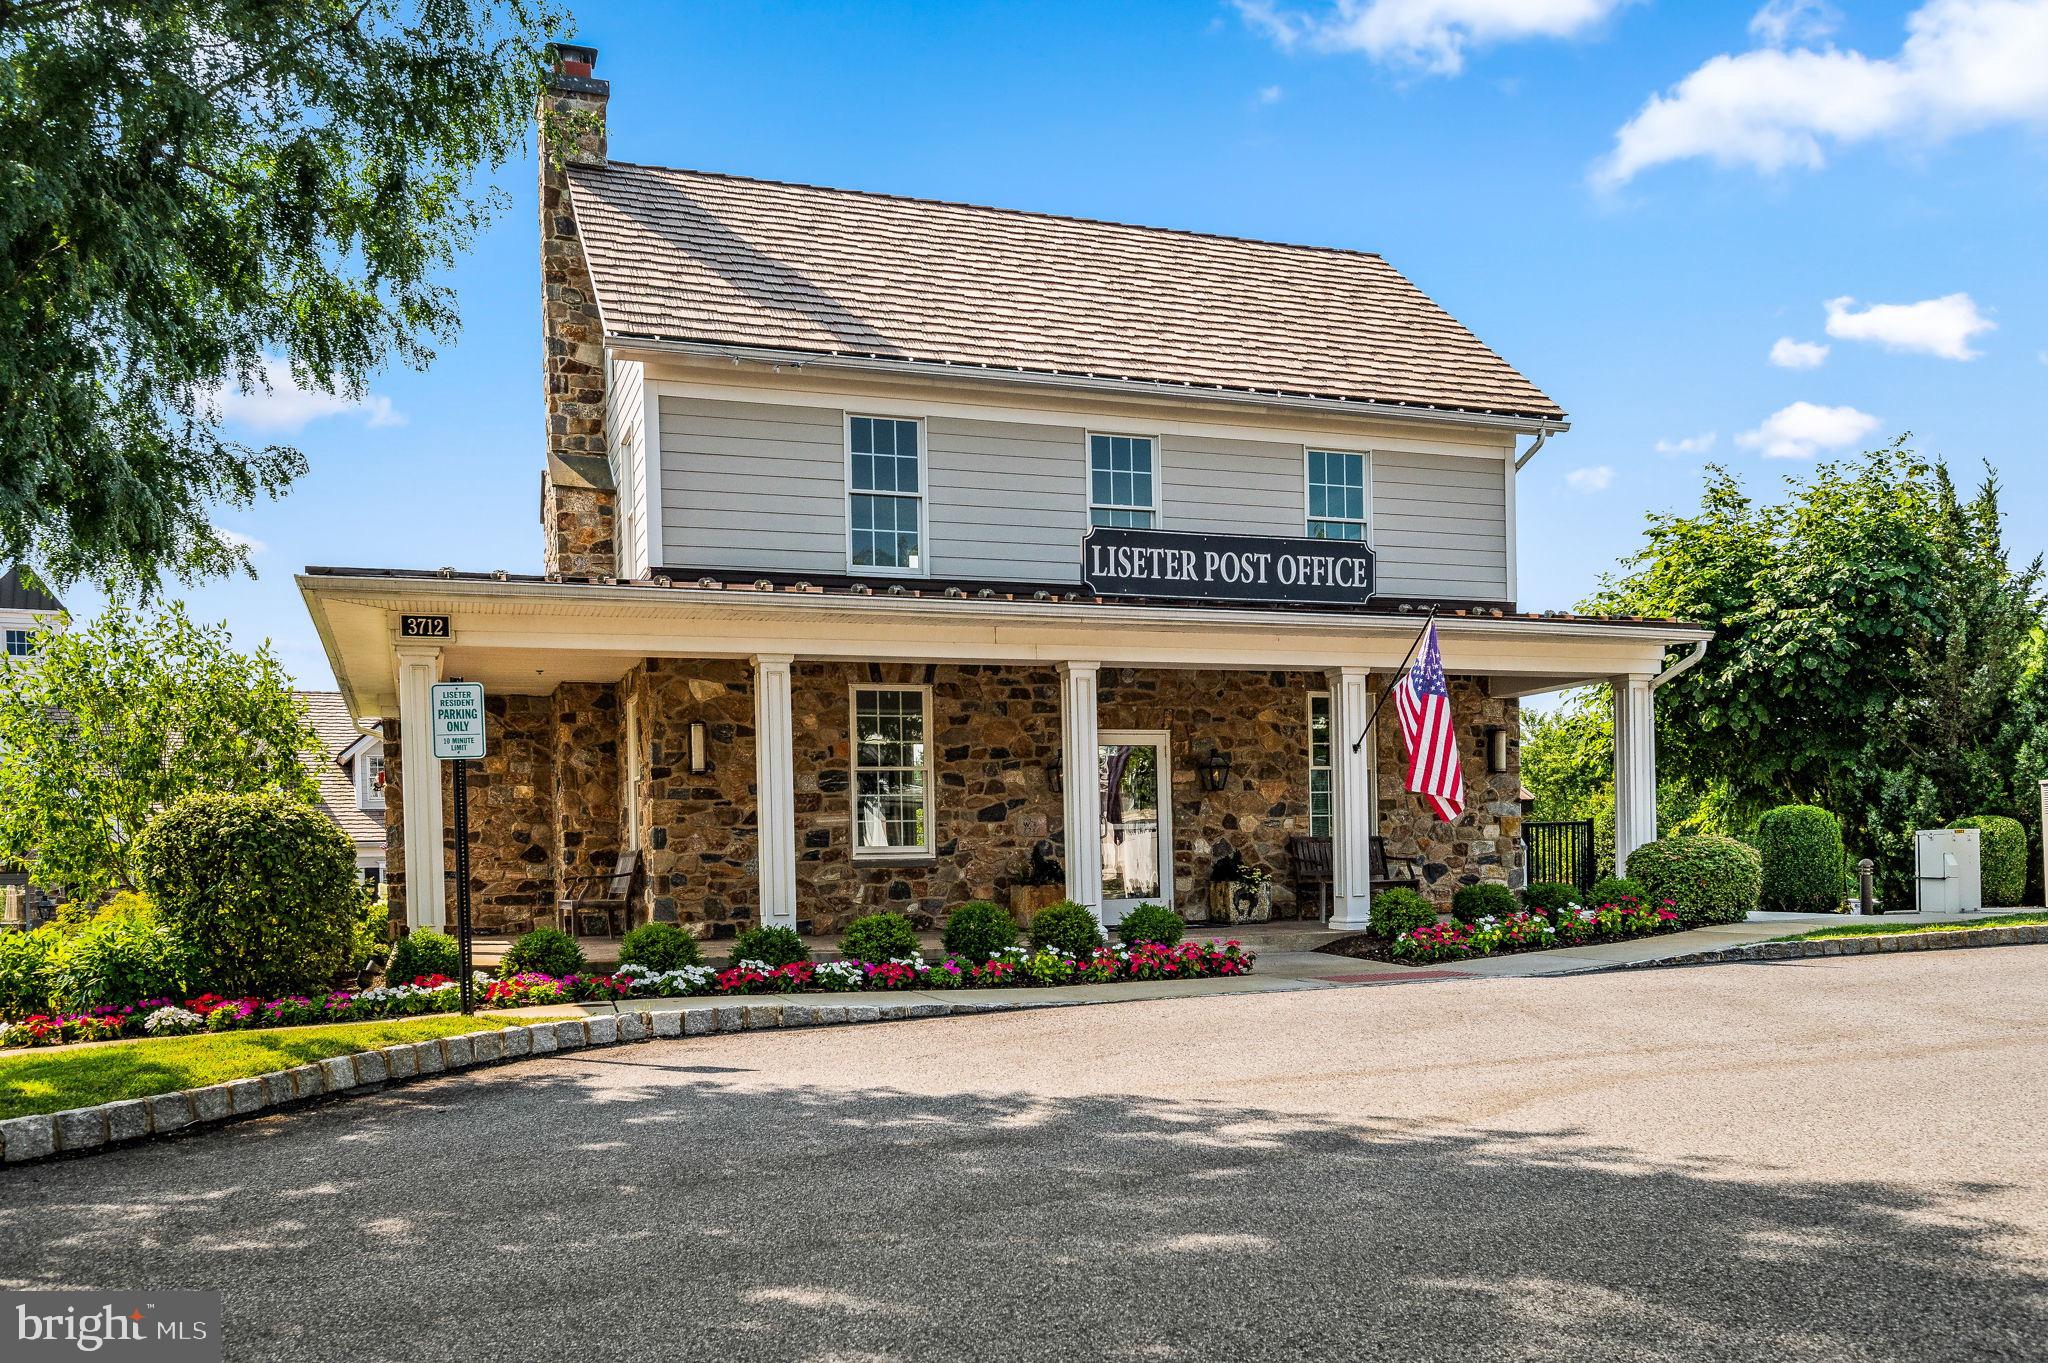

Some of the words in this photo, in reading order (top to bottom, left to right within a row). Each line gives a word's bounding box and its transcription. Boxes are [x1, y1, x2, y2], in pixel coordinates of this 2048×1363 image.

[1091, 545, 1198, 581] LISETER
[1204, 551, 1271, 583] POST
[1277, 554, 1367, 587] OFFICE
[407, 618, 443, 636] 3712
[442, 691, 472, 699] LISETER
[440, 699, 475, 707] RESIDENT
[438, 708, 478, 720] PARKING
[446, 721, 470, 732] ONLY
